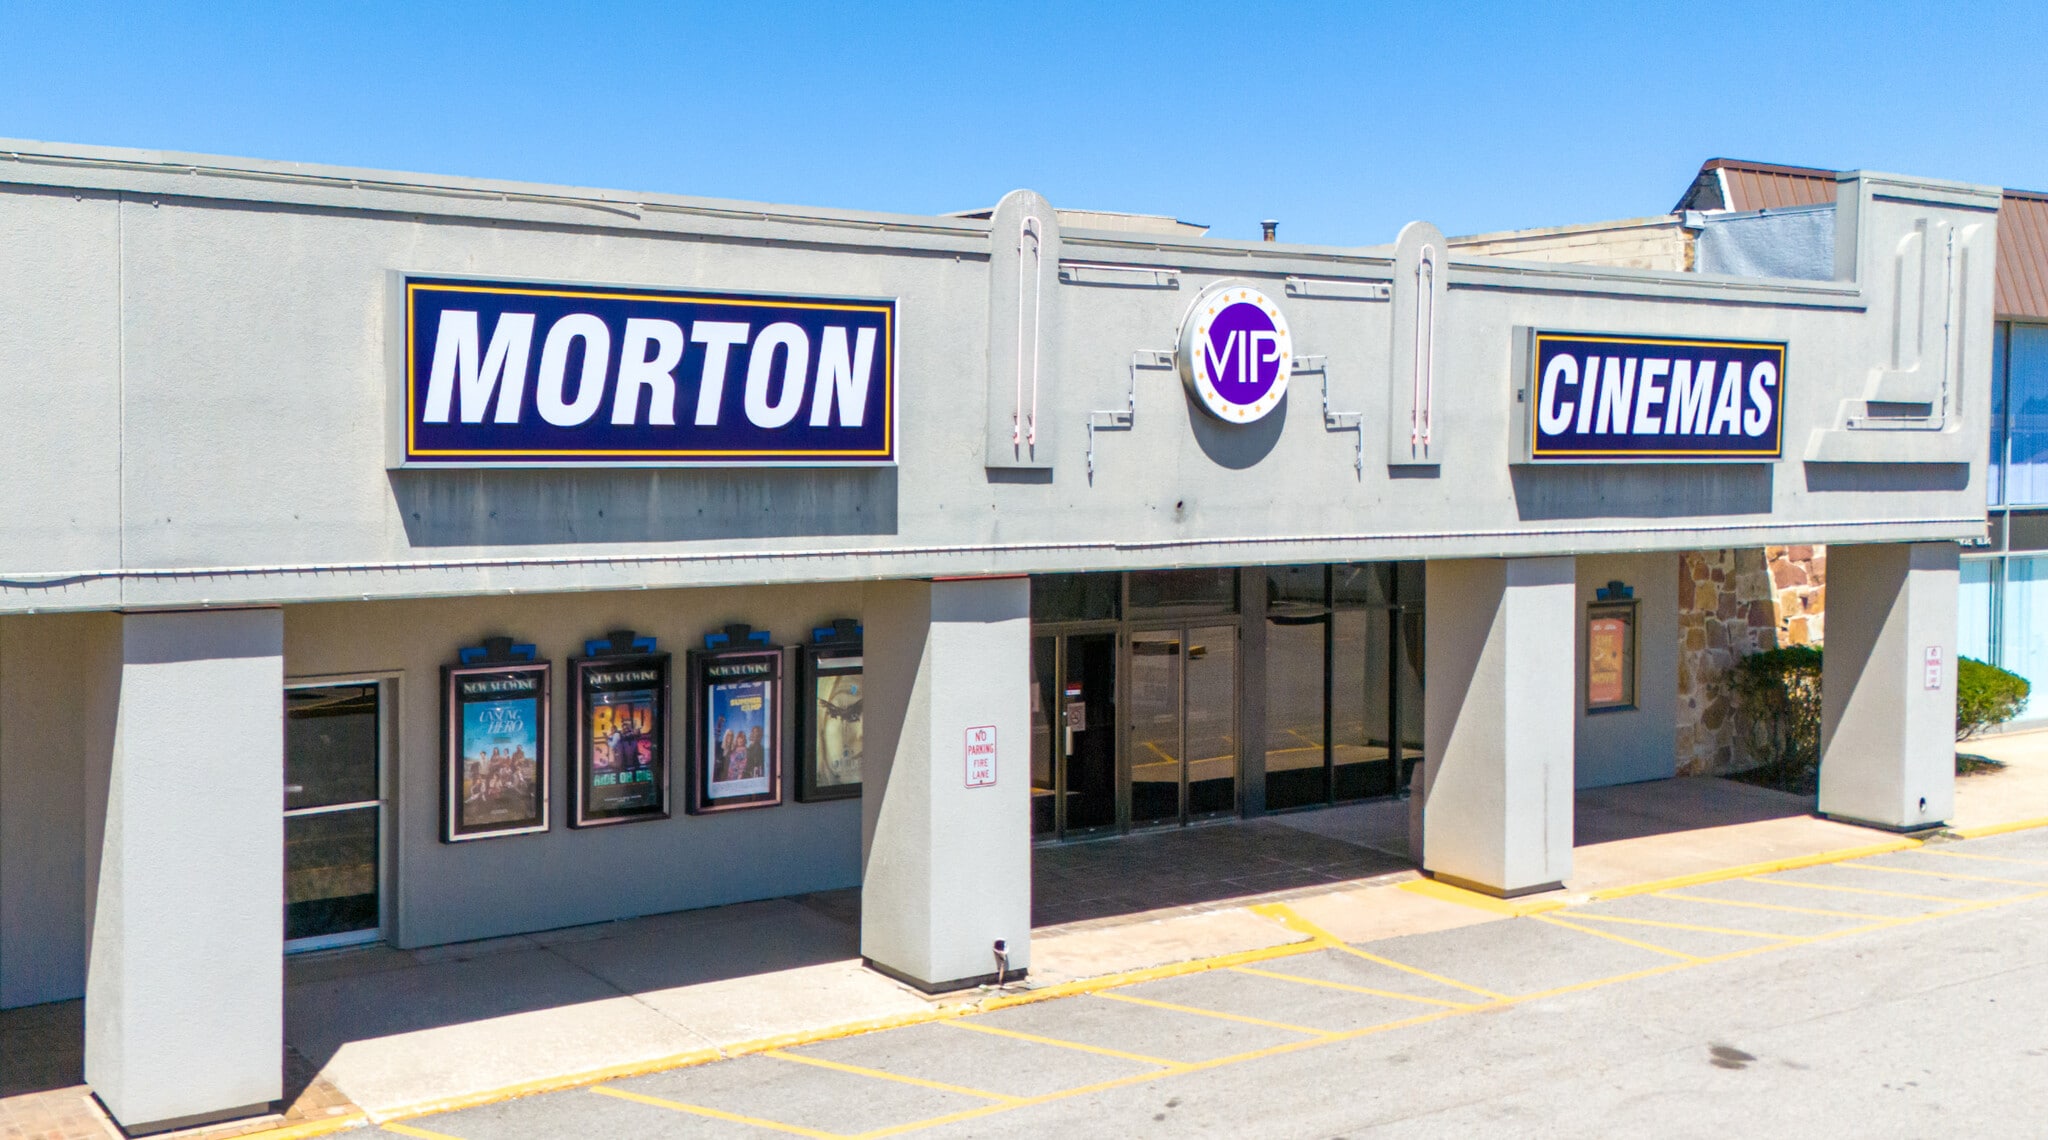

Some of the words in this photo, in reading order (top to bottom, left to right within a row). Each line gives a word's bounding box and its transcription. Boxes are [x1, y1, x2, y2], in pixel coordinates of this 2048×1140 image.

[1202, 330, 1280, 383] VIP
[423, 309, 877, 428] MORTON
[1538, 353, 1777, 437] CINEMAS
[709, 666, 729, 676] NOW
[590, 673, 611, 684] NOW
[464, 682, 487, 693] NOW
[488, 720, 523, 734] HERO
[593, 704, 652, 738] BAD
[975, 731, 987, 742] NO
[593, 739, 652, 768] BS
[968, 743, 994, 755] PARKING
[973, 759, 988, 768] FIRE
[593, 773, 617, 787] RIDE
[619, 771, 633, 784] OR
[972, 769, 989, 780] LANE
